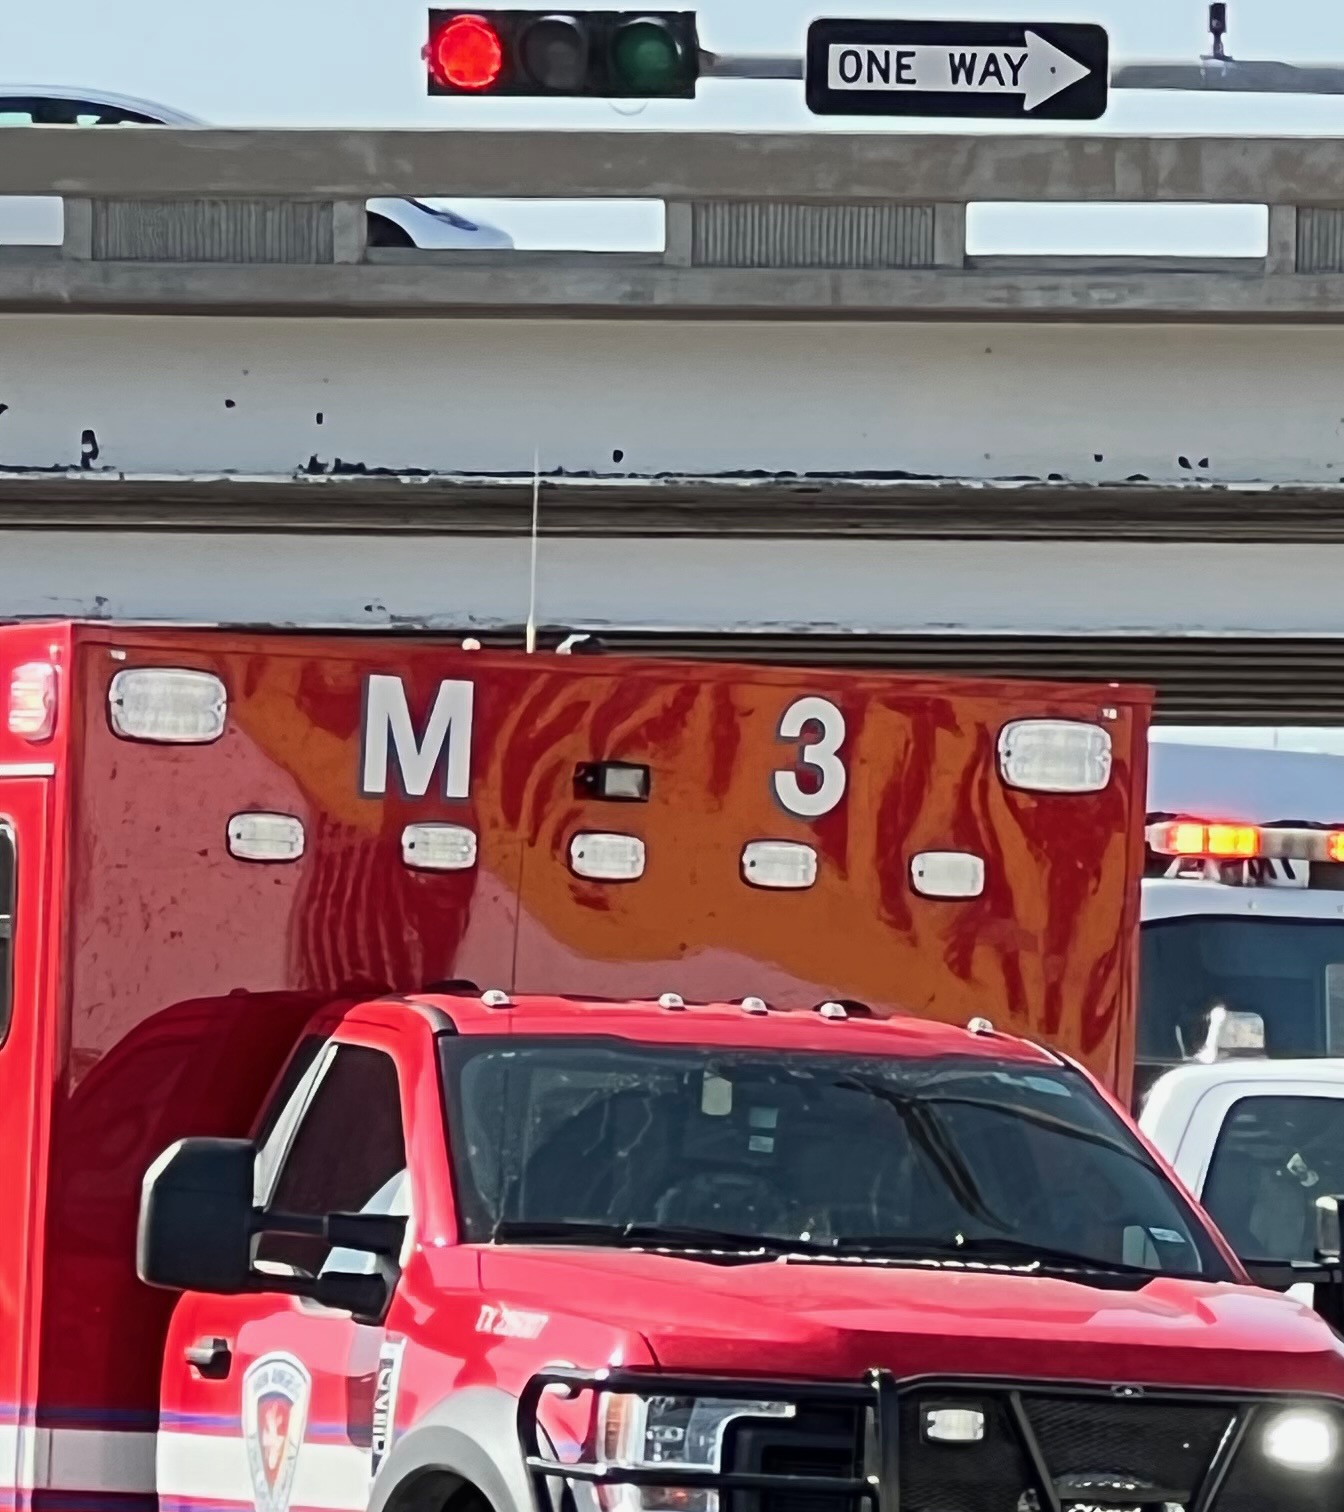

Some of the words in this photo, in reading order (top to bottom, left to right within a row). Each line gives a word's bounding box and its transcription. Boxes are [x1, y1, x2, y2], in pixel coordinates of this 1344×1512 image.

[838, 50, 917, 85] ONE
[948, 52, 1028, 87] WAY
[362, 673, 475, 799] M
[774, 696, 847, 818] 3
